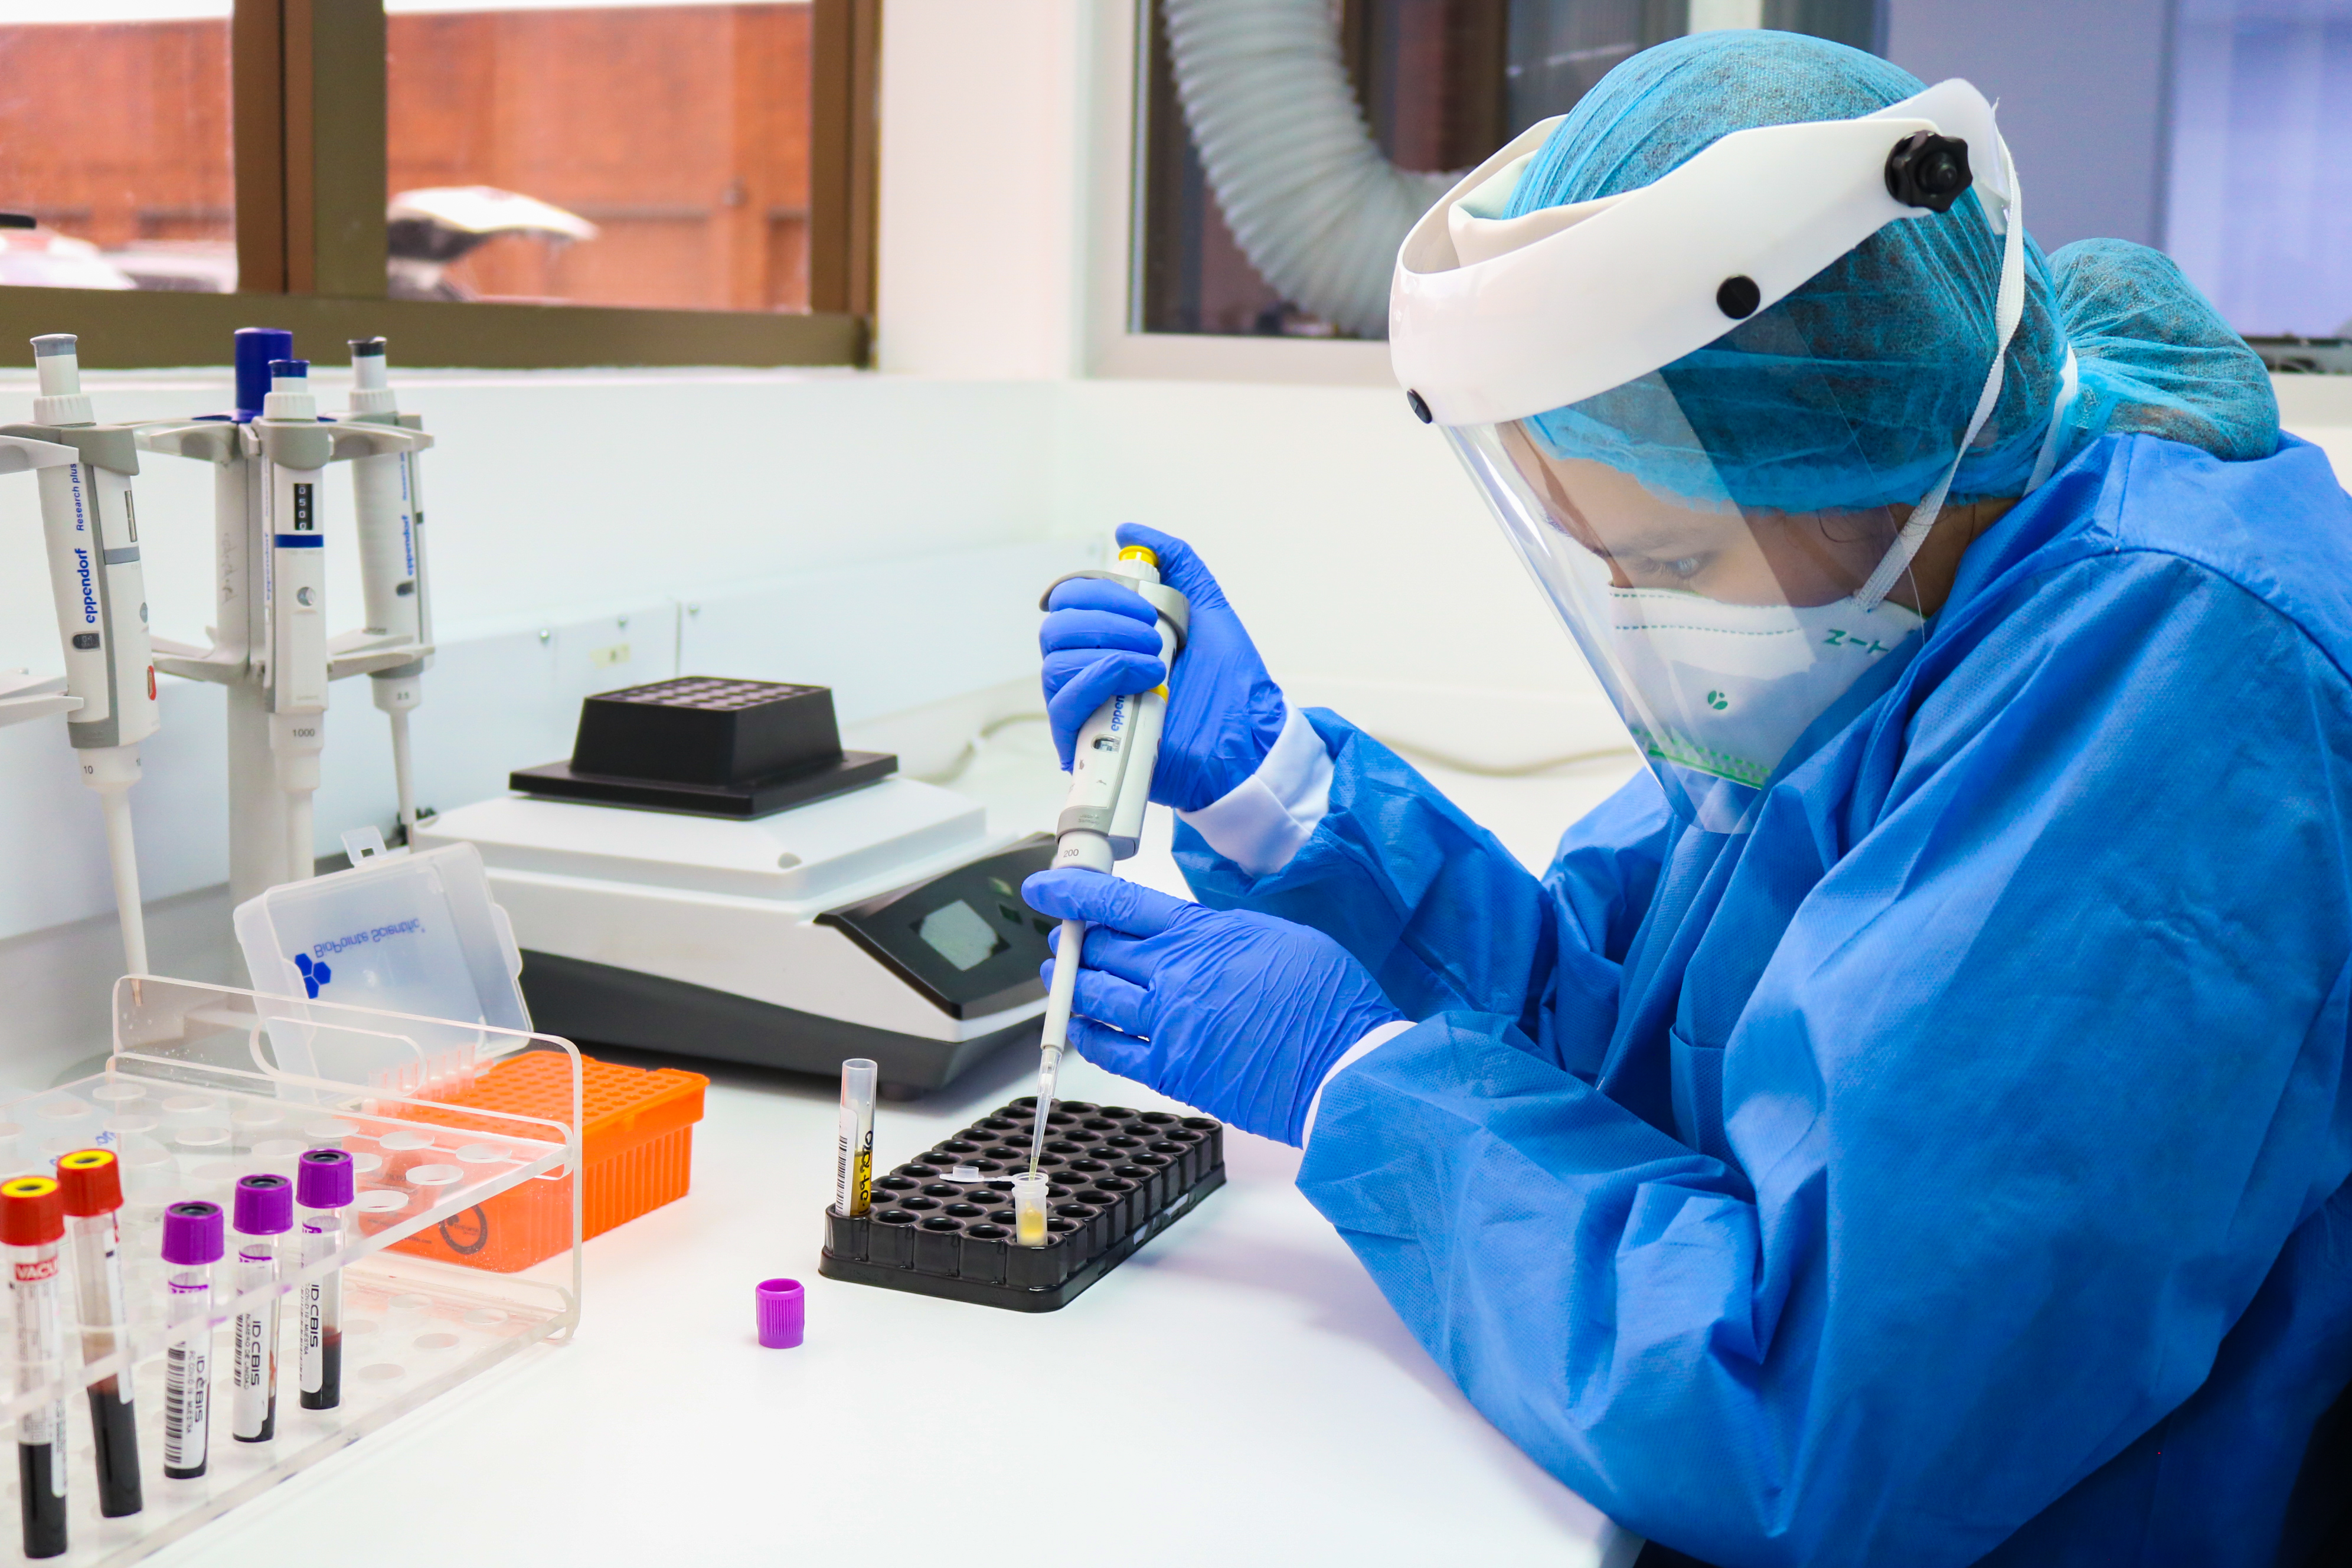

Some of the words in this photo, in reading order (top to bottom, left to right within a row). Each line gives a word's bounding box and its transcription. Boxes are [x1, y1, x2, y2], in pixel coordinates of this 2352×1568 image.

[70, 463, 81, 483] plus
[71, 486, 85, 531] Research
[75, 548, 99, 624] eppendorf
[292, 728, 316, 737] 1000
[83, 765, 94, 775] 10
[1063, 848, 1079, 858] 200
[311, 1284, 320, 1301] ID
[253, 1321, 261, 1337] ID
[310, 1305, 319, 1347] CBIS
[197, 1355, 205, 1373] ID
[251, 1341, 261, 1386] CBIS
[195, 1377, 205, 1423] CBIS
